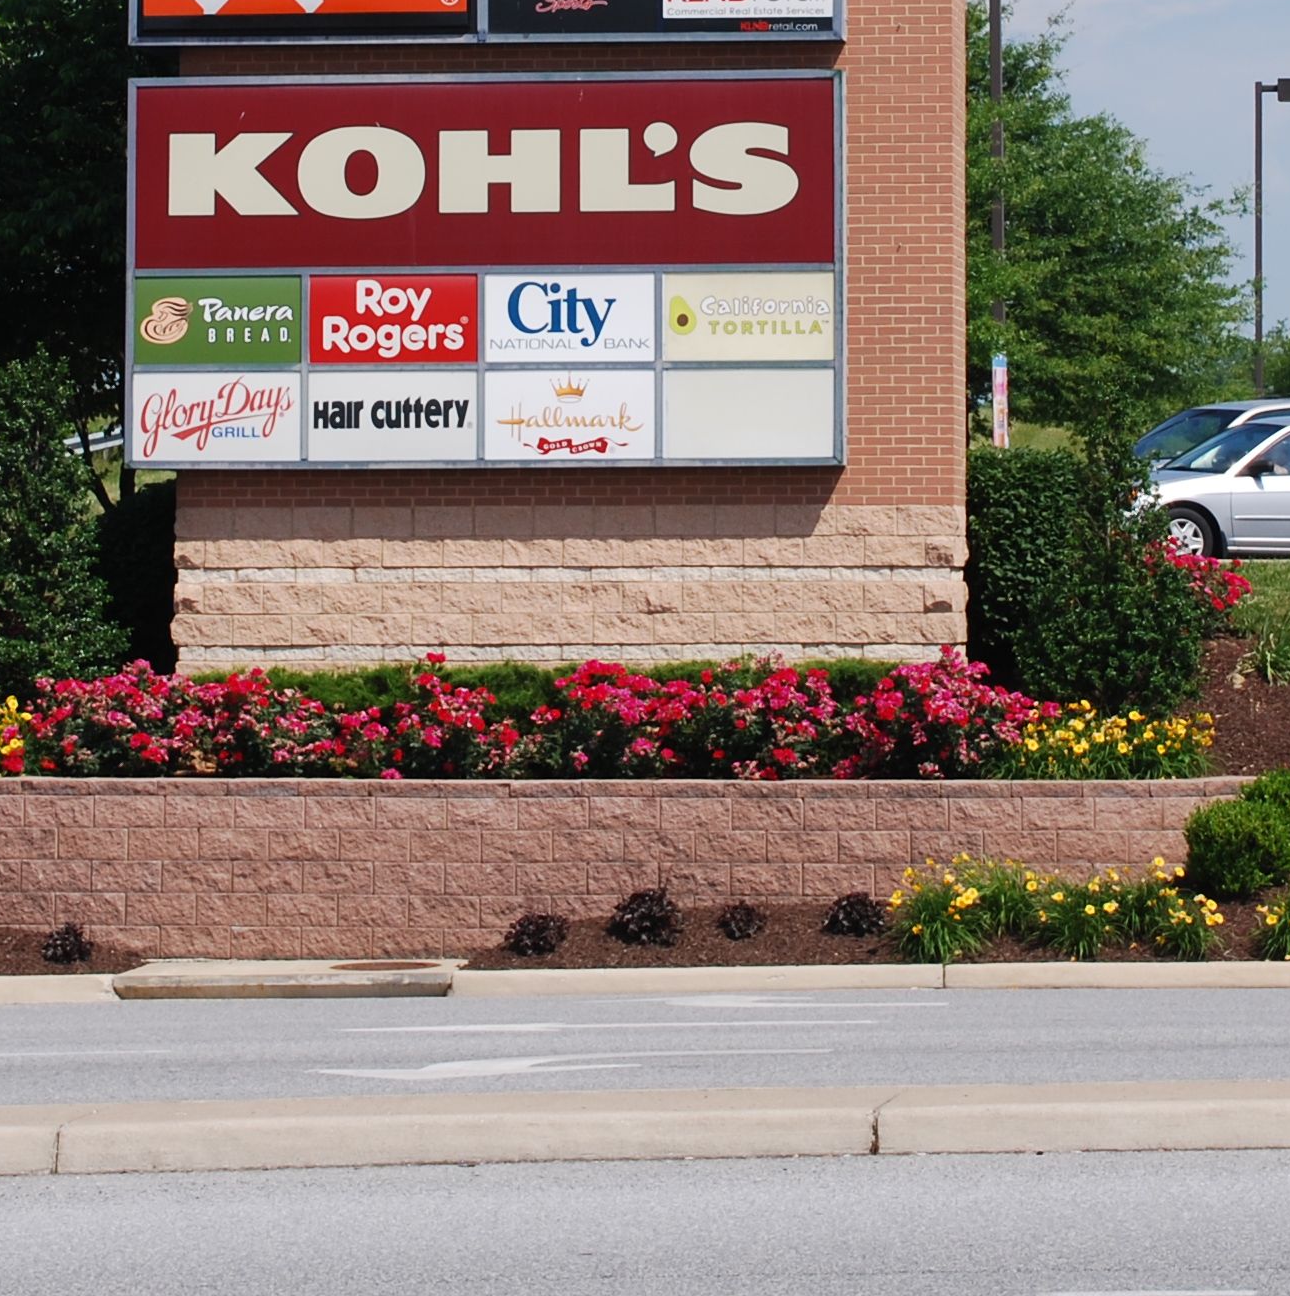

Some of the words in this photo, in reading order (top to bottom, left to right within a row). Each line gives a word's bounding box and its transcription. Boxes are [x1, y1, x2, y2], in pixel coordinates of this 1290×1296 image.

[667, 7, 727, 17] Commercial
[729, 6, 751, 16] Real
[753, 6, 783, 16] Estate
[786, 6, 825, 16] Services
[167, 121, 799, 220] KOHL'S
[198, 298, 294, 323] Panera
[356, 279, 432, 322] Roy
[507, 281, 617, 347] City
[700, 295, 830, 316] California
[322, 315, 465, 359] Rogers
[708, 320, 823, 335] TORTILLA
[489, 338, 577, 350] NATIONAL
[604, 338, 650, 349] BANK
[140, 388, 216, 458] Glory
[214, 375, 294, 438] Days
[313, 400, 364, 429] Hair
[496, 401, 645, 442] Hallmark
[211, 426, 260, 438] GRILL
